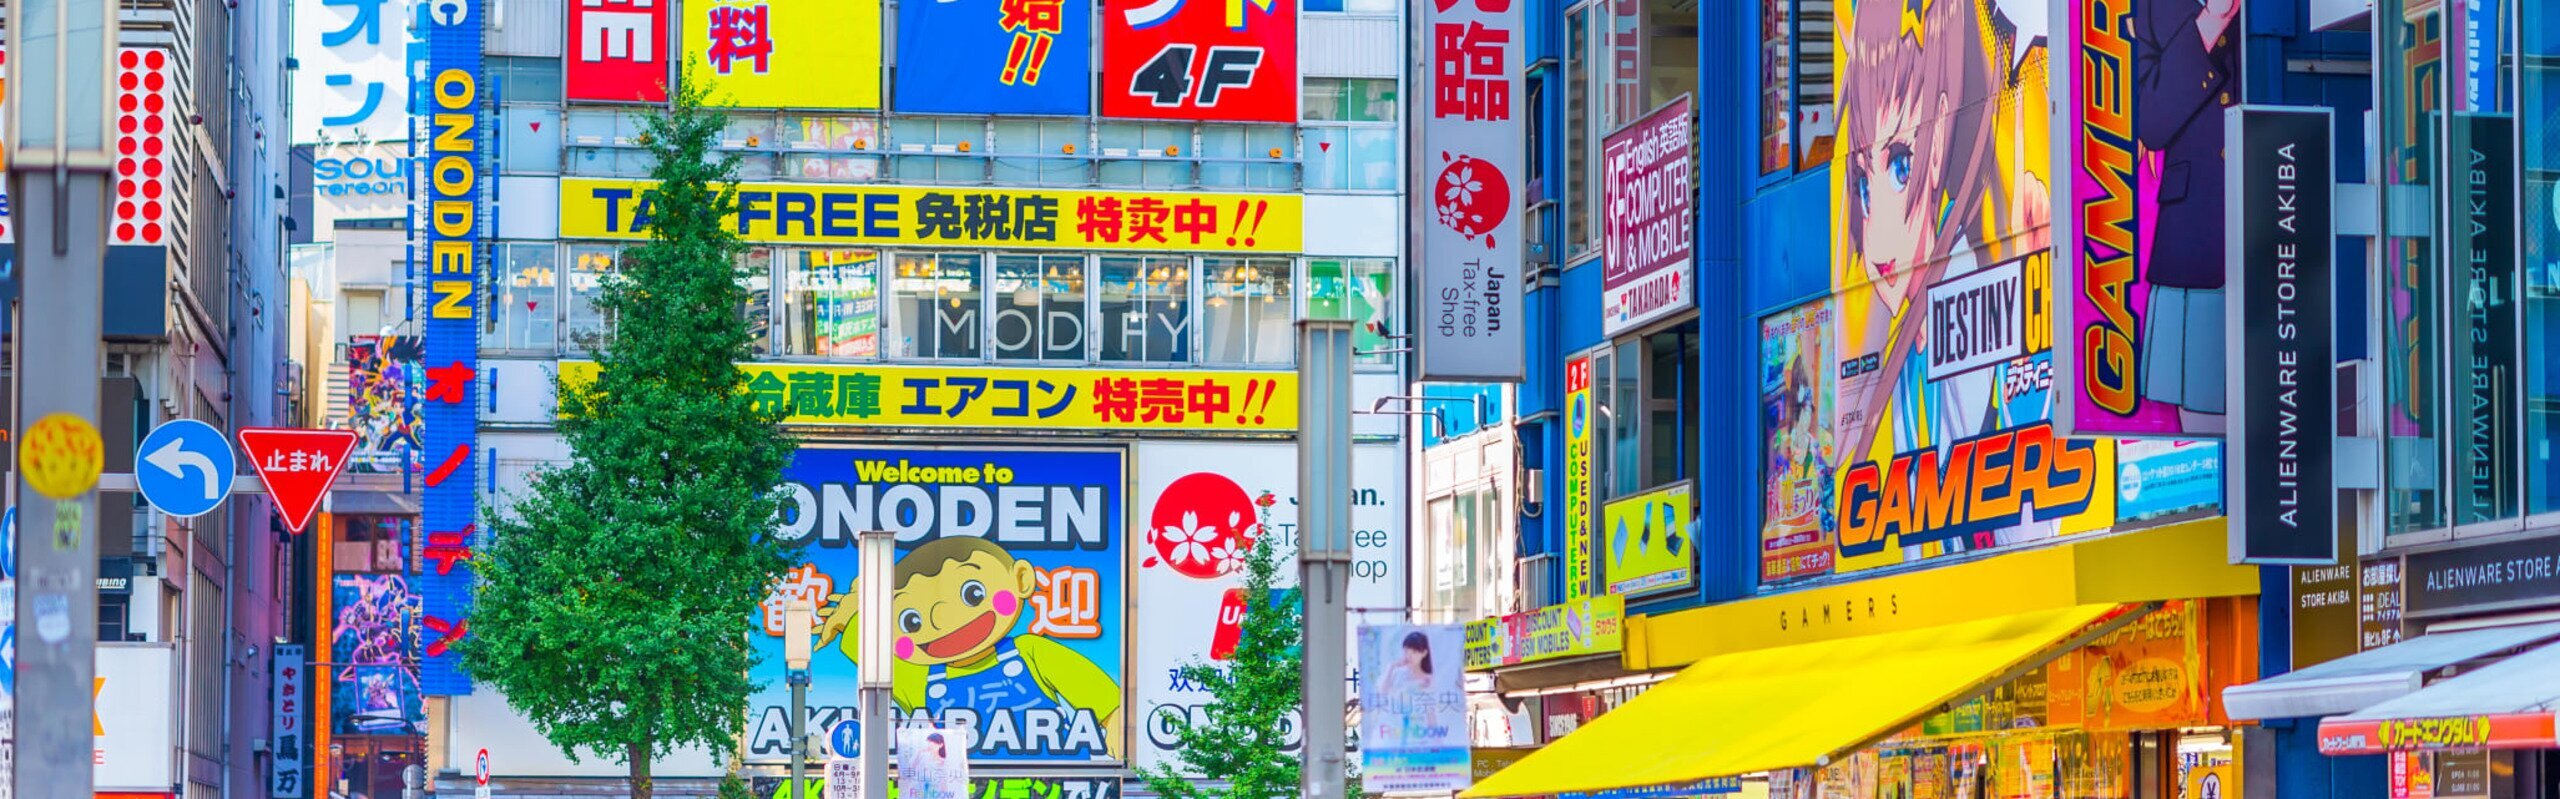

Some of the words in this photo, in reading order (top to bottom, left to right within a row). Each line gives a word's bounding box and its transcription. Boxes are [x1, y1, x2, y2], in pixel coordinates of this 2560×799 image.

[1130, 43, 1265, 107] 4F
[1435, 0, 1510, 121] 臨
[1626, 125, 1659, 176] English
[432, 69, 475, 318] ONODEN
[738, 191, 900, 238] FREE
[915, 193, 1058, 242] 免税店
[1626, 155, 1690, 228] COMPUTER
[2278, 142, 2296, 233] AKIBA
[1626, 233, 1637, 273] &
[1639, 208, 1690, 269] MOBILE
[1437, 287, 1459, 338] Shop
[1462, 257, 1481, 338] Tax-free
[1487, 267, 1505, 336] Japan.
[1932, 275, 2018, 369] DESTINY
[2278, 243, 2297, 341] STORE
[936, 308, 1191, 353] MODIFY
[744, 370, 882, 419] 冷蔵庫
[901, 376, 1078, 420] エアコン
[263, 448, 333, 473] 止まれ
[2279, 350, 2298, 527] ALIENWARE
[854, 460, 981, 484] Welcome
[983, 461, 1014, 484] to
[1837, 422, 2097, 553] GAMERS
[771, 483, 1103, 545] ONODEN
[1569, 442, 1579, 600] COMPUTERS
[2301, 566, 2351, 585] ALIENWARE
[2301, 592, 2326, 609] STORE
[2327, 590, 2351, 606] AKIBA
[2426, 562, 2503, 592] ALIENWARE
[2506, 556, 2552, 582] STORE
[1780, 593, 1899, 631] GAMERS
